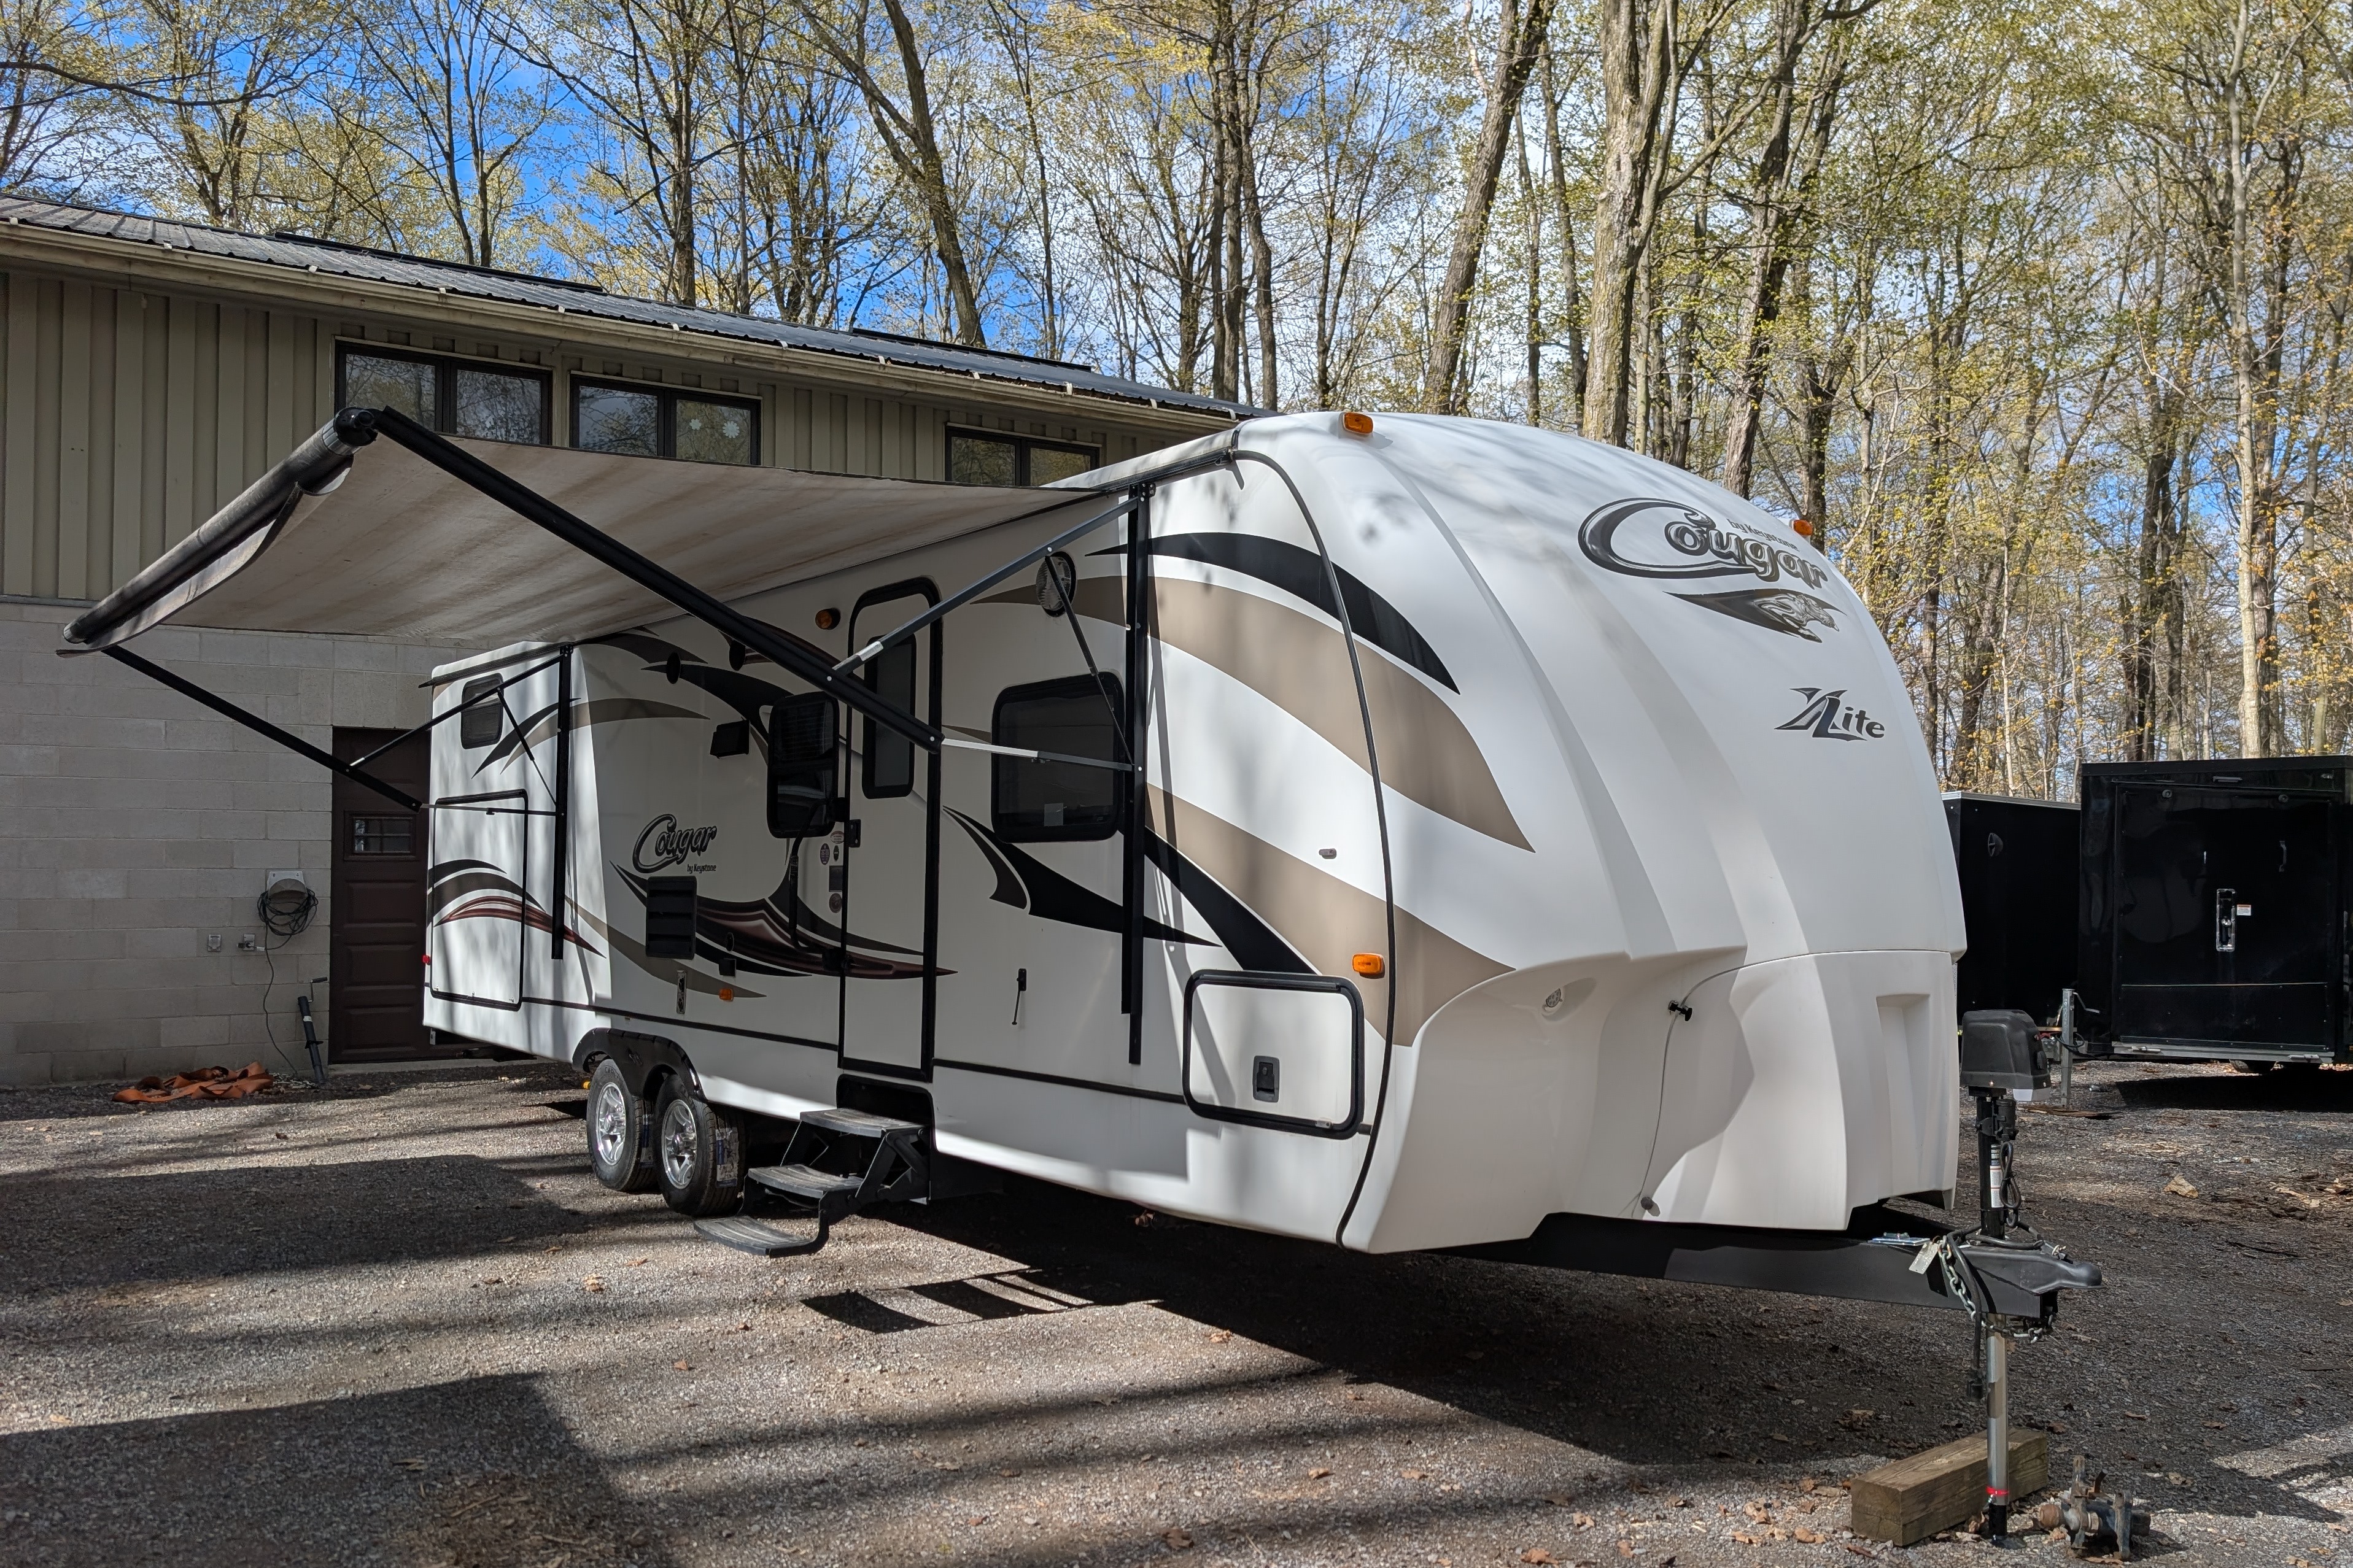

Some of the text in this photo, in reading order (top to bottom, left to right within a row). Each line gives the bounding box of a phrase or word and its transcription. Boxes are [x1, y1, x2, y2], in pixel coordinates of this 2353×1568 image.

[1578, 498, 1828, 589] Cougar
[1726, 518, 1800, 552] by Keystone
[632, 813, 718, 873] Cougar
[687, 863, 716, 874] by Keystone
